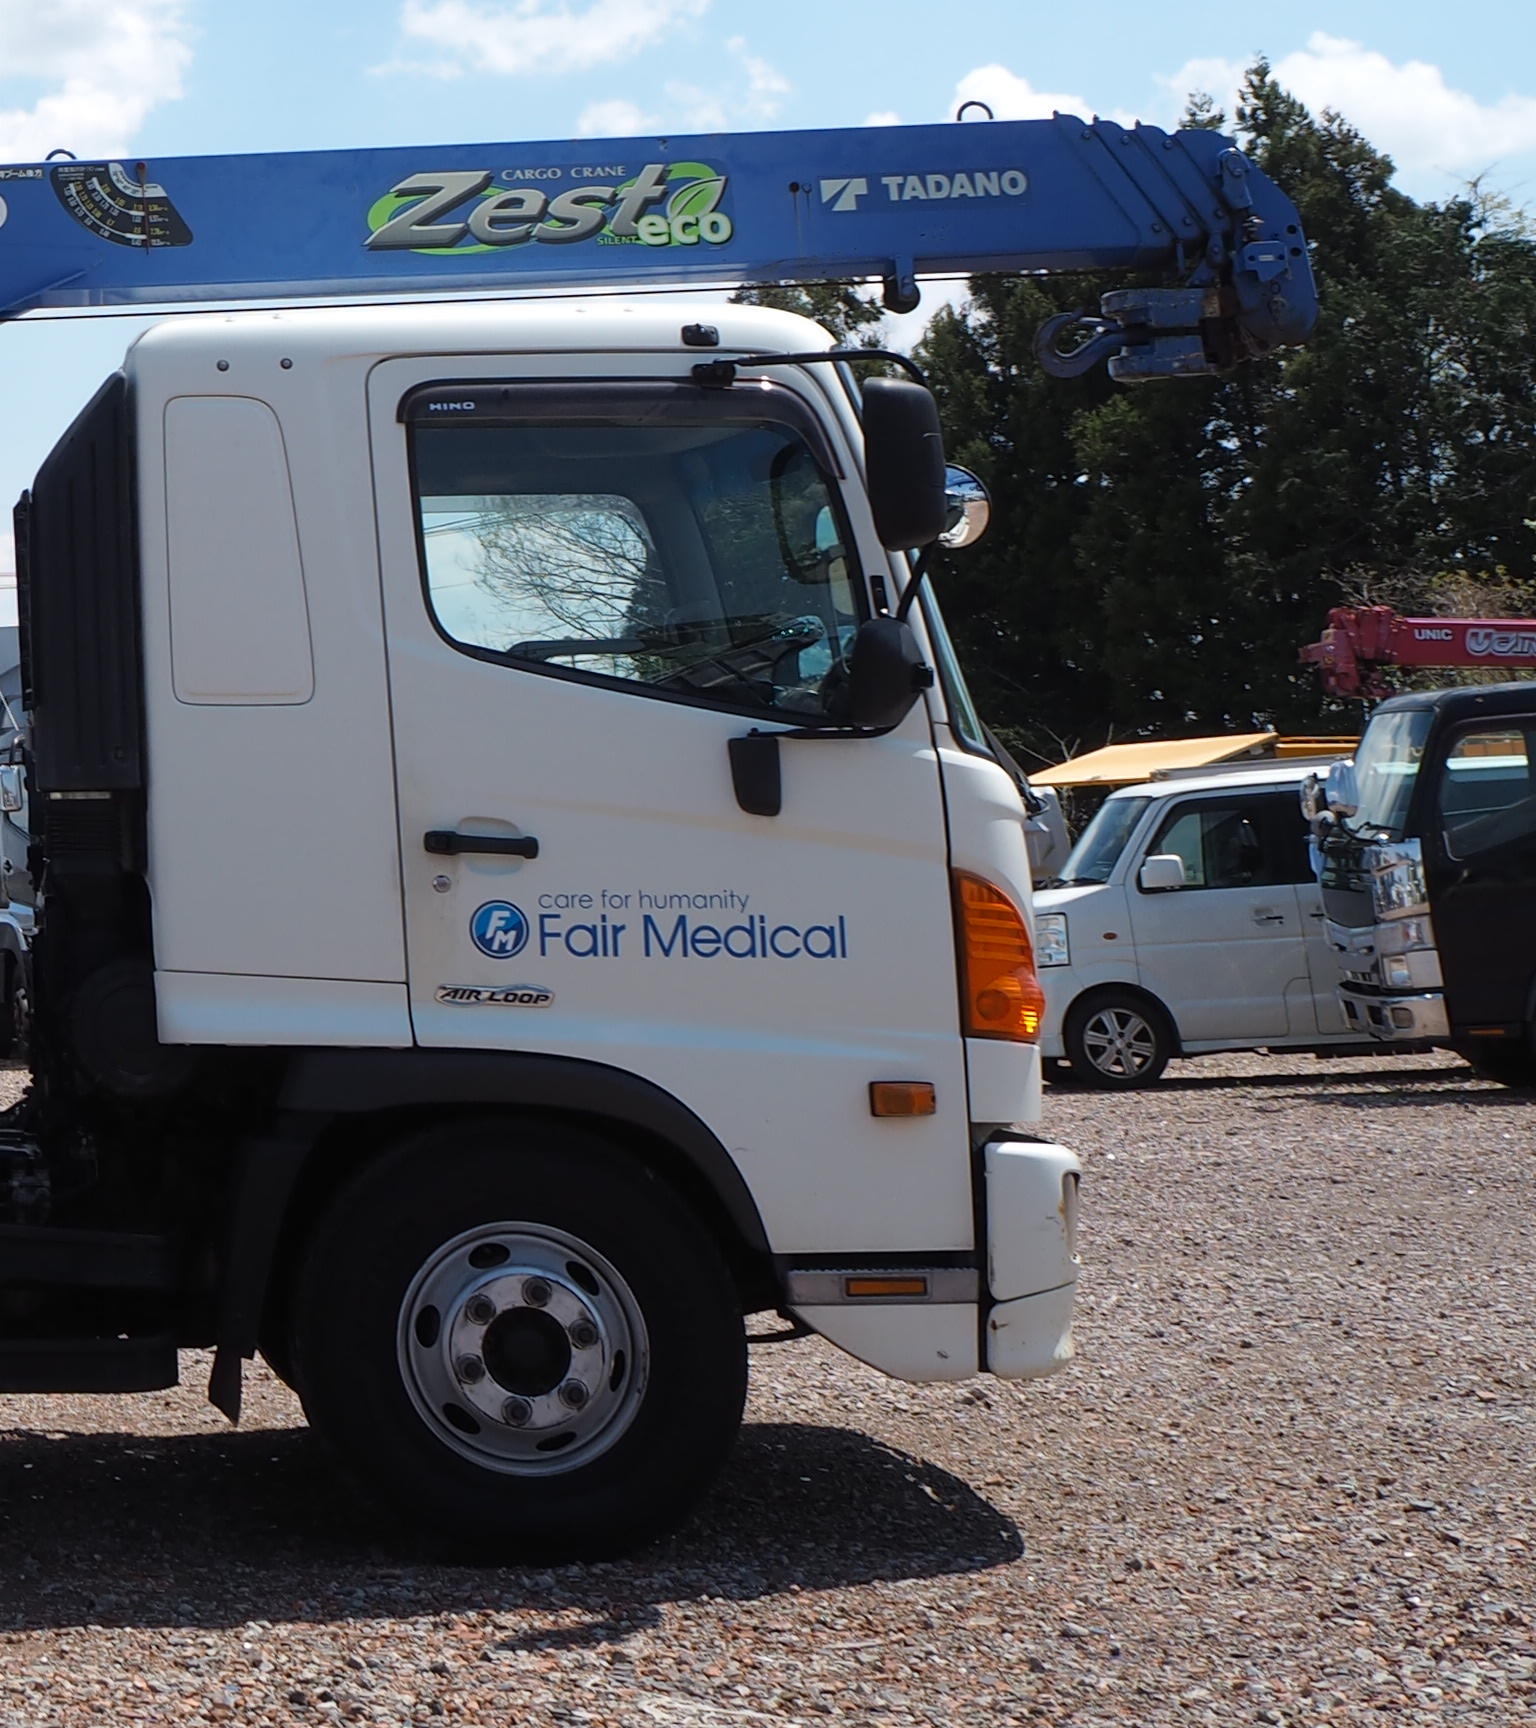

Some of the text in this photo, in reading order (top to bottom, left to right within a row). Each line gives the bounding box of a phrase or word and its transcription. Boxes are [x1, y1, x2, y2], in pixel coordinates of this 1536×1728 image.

[501, 165, 626, 181] CARGO CRANE
[881, 170, 1027, 201] TADANO
[362, 163, 668, 250] Zest
[636, 211, 732, 246] eco
[429, 401, 476, 411] HINO
[1414, 628, 1453, 641] UNIC
[538, 889, 750, 913] care for humanity
[485, 910, 516, 951] FM
[538, 913, 847, 959] Fair Medical
[439, 988, 550, 1005] AIR LOOP
